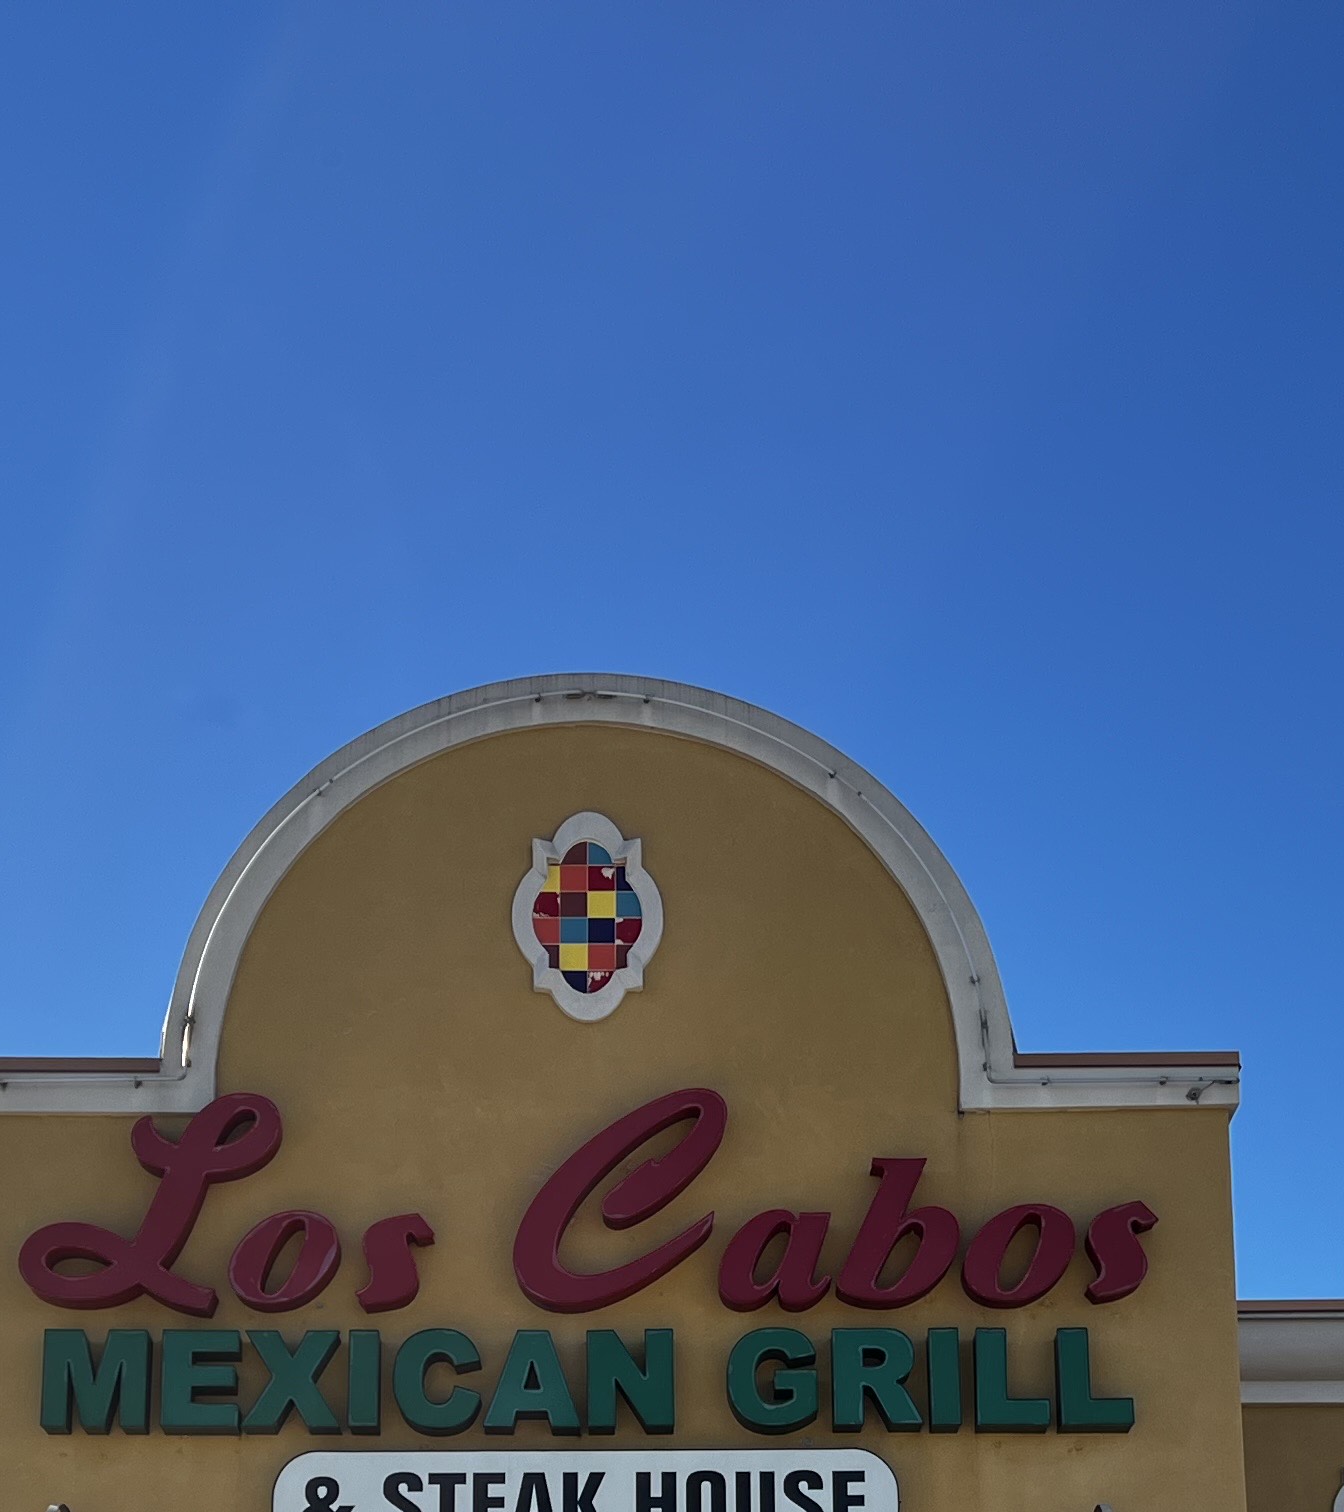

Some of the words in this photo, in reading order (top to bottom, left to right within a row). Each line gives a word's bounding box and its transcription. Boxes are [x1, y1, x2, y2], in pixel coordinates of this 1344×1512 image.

[18, 1093, 435, 1318] Los
[512, 1087, 1159, 1313] Cabos
[40, 1328, 675, 1437] MEXICAN
[726, 1326, 1135, 1435] GRILL
